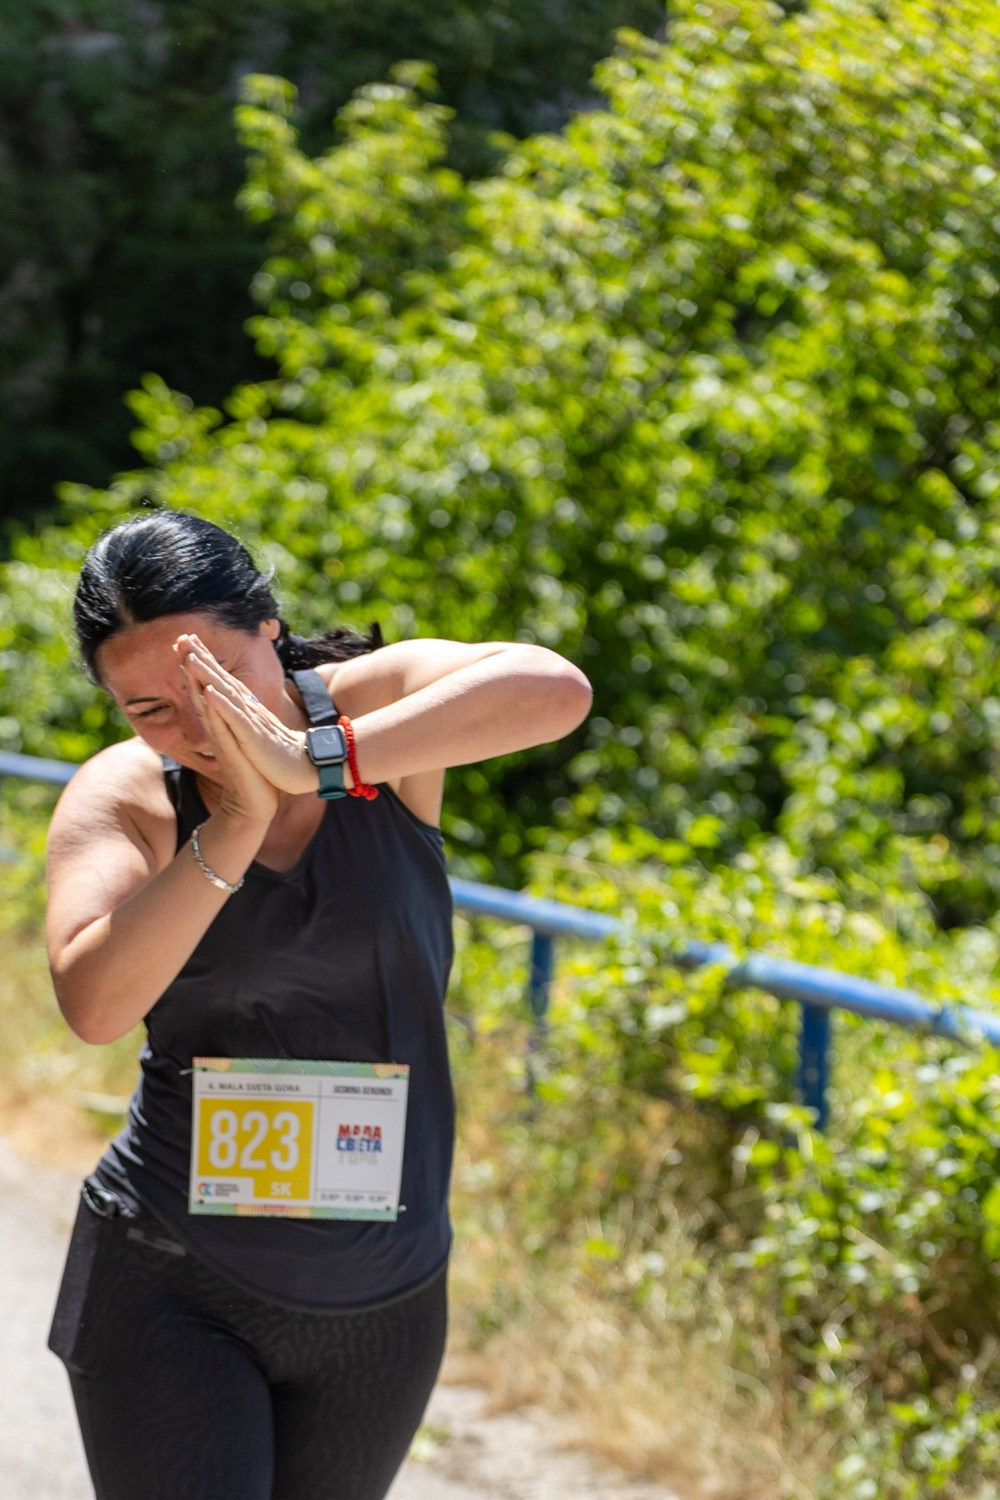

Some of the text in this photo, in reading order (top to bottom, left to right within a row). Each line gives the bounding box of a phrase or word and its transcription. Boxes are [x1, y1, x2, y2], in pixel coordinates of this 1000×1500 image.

[218, 1082, 244, 1091] MALA
[246, 1083, 272, 1092] SVETA
[274, 1084, 301, 1093] GORA
[208, 1109, 300, 1171] 823
[270, 1181, 293, 1198] 5K
